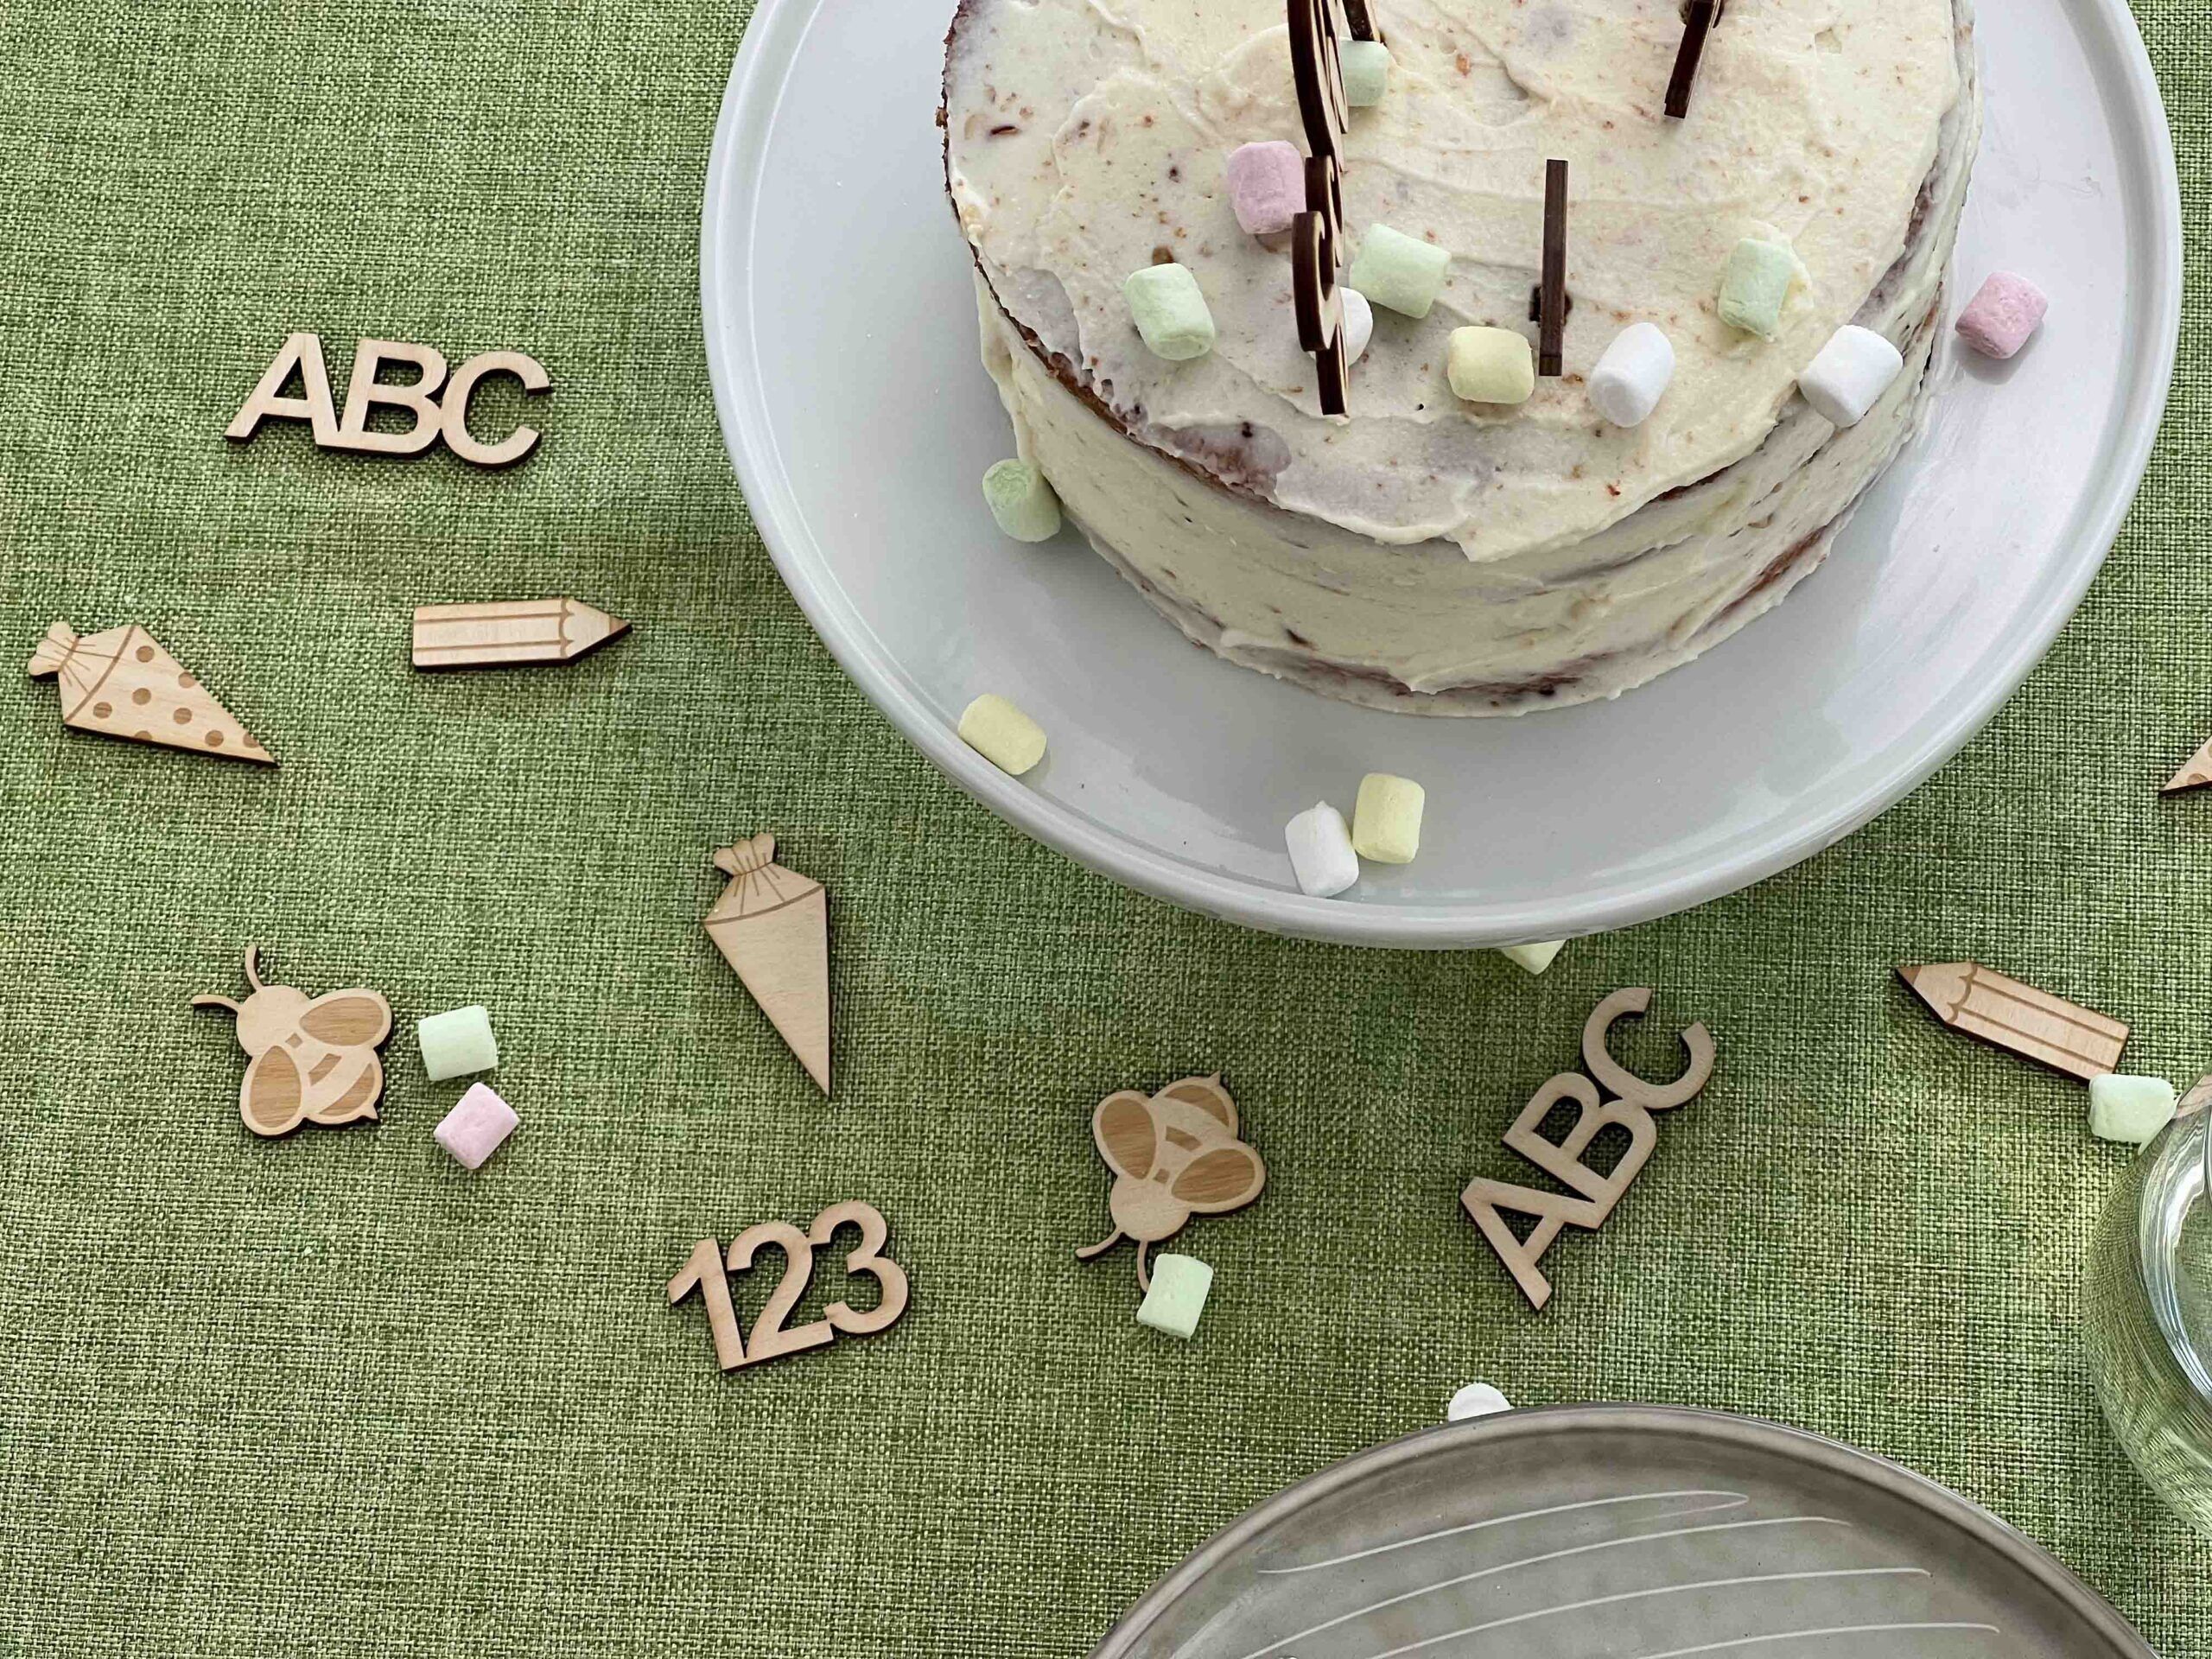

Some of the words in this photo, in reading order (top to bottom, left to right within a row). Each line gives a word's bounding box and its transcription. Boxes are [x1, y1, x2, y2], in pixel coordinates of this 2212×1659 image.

[225, 333, 550, 465] ABC
[1459, 987, 1715, 1312] ABC
[667, 1199, 908, 1370] 123
